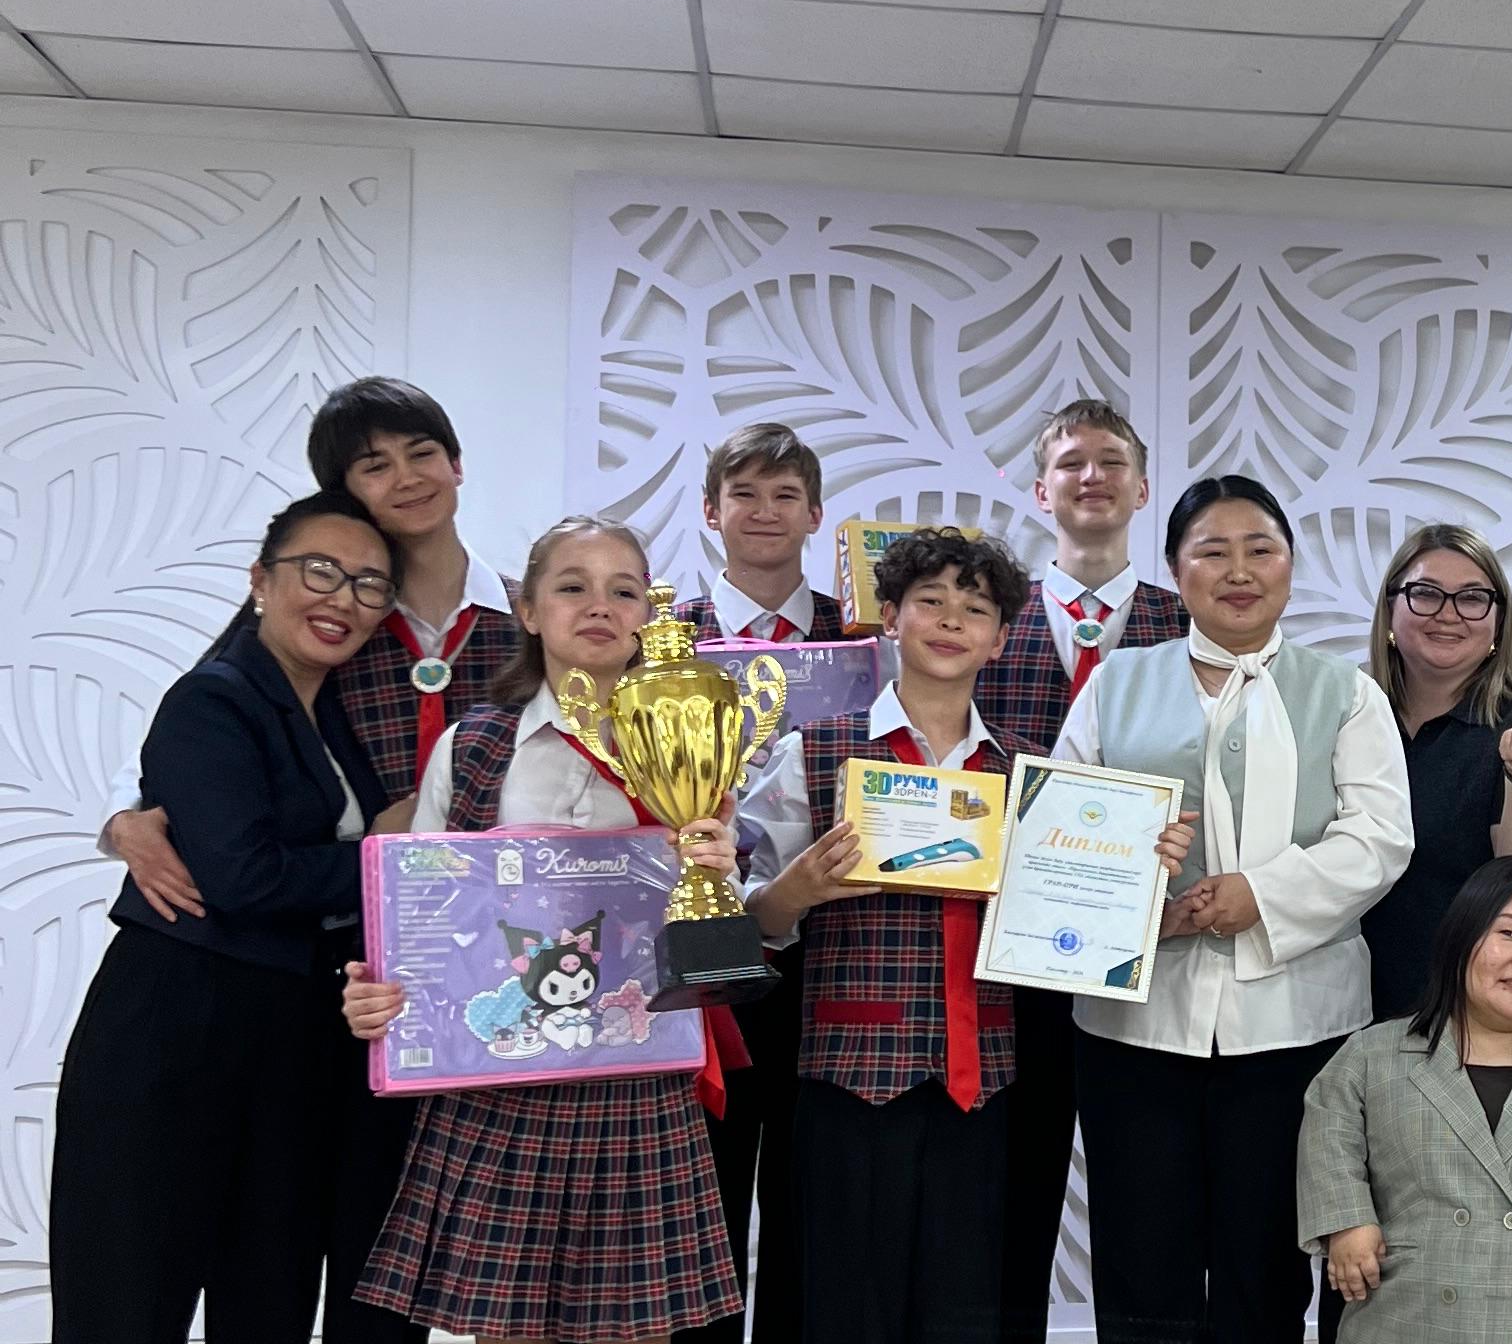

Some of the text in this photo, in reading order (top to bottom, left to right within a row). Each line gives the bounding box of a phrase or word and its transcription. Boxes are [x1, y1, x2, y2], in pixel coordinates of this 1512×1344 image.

[862, 770, 939, 795] 3D РУЧКА
[894, 786, 938, 799] 3DPEN-2
[1036, 827, 1135, 858] Диплом
